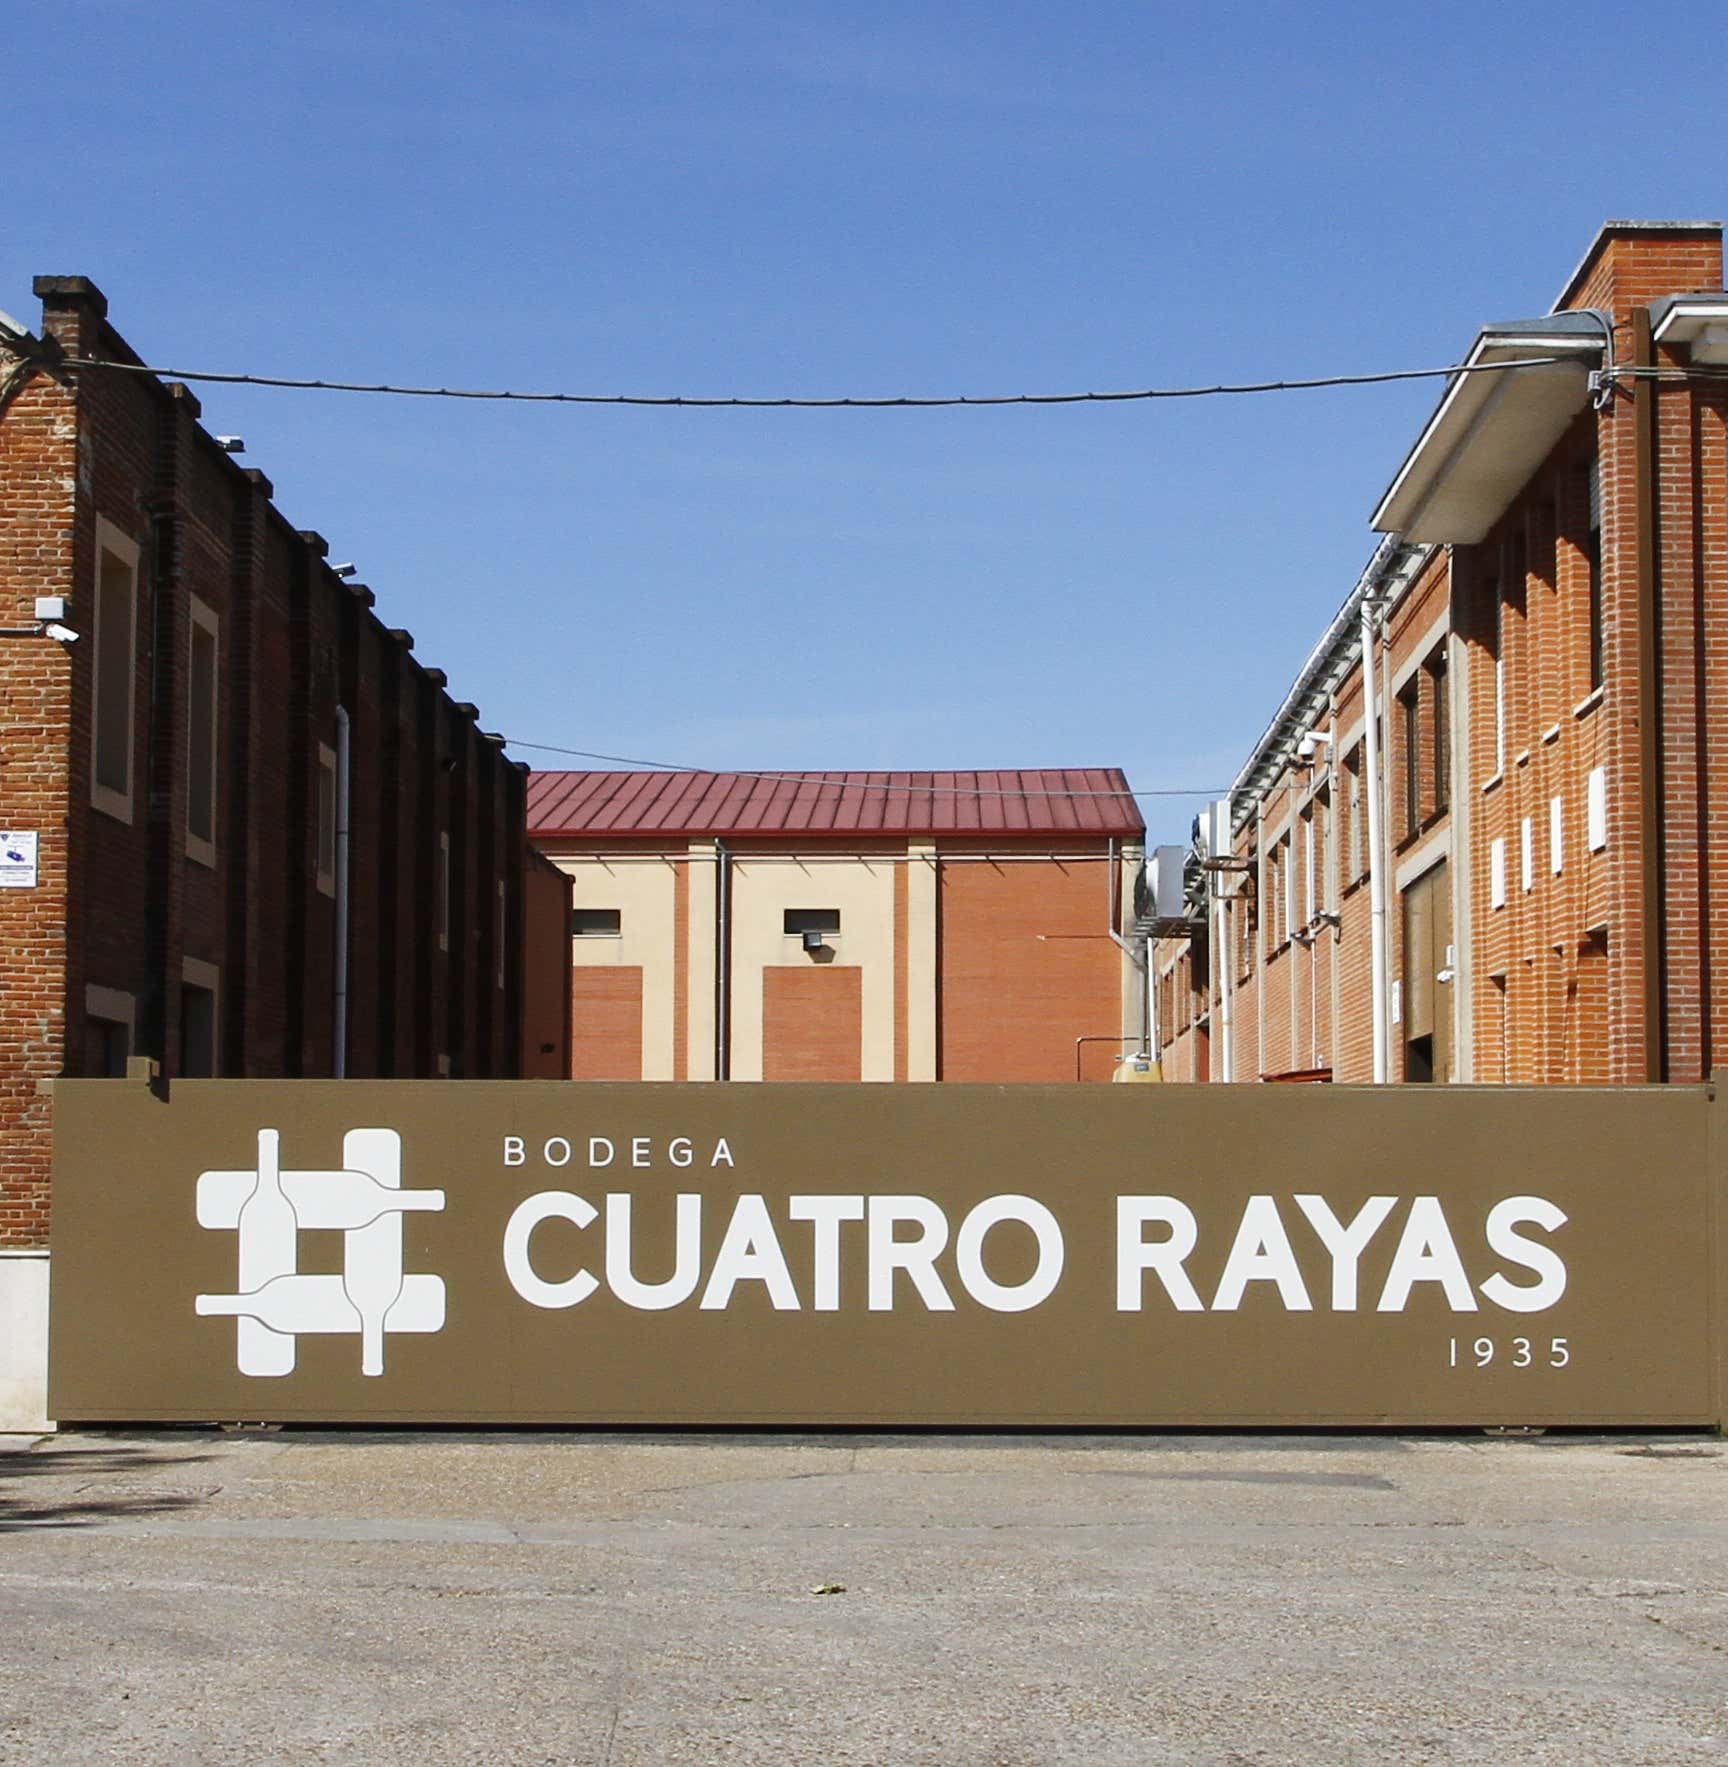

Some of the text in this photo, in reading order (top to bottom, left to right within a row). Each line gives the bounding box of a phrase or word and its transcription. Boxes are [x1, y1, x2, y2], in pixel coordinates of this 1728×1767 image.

[503, 1136, 735, 1167] BODEGA
[503, 1190, 1569, 1313] CUATRO RAYAS
[1449, 1337, 1570, 1368] 1935
